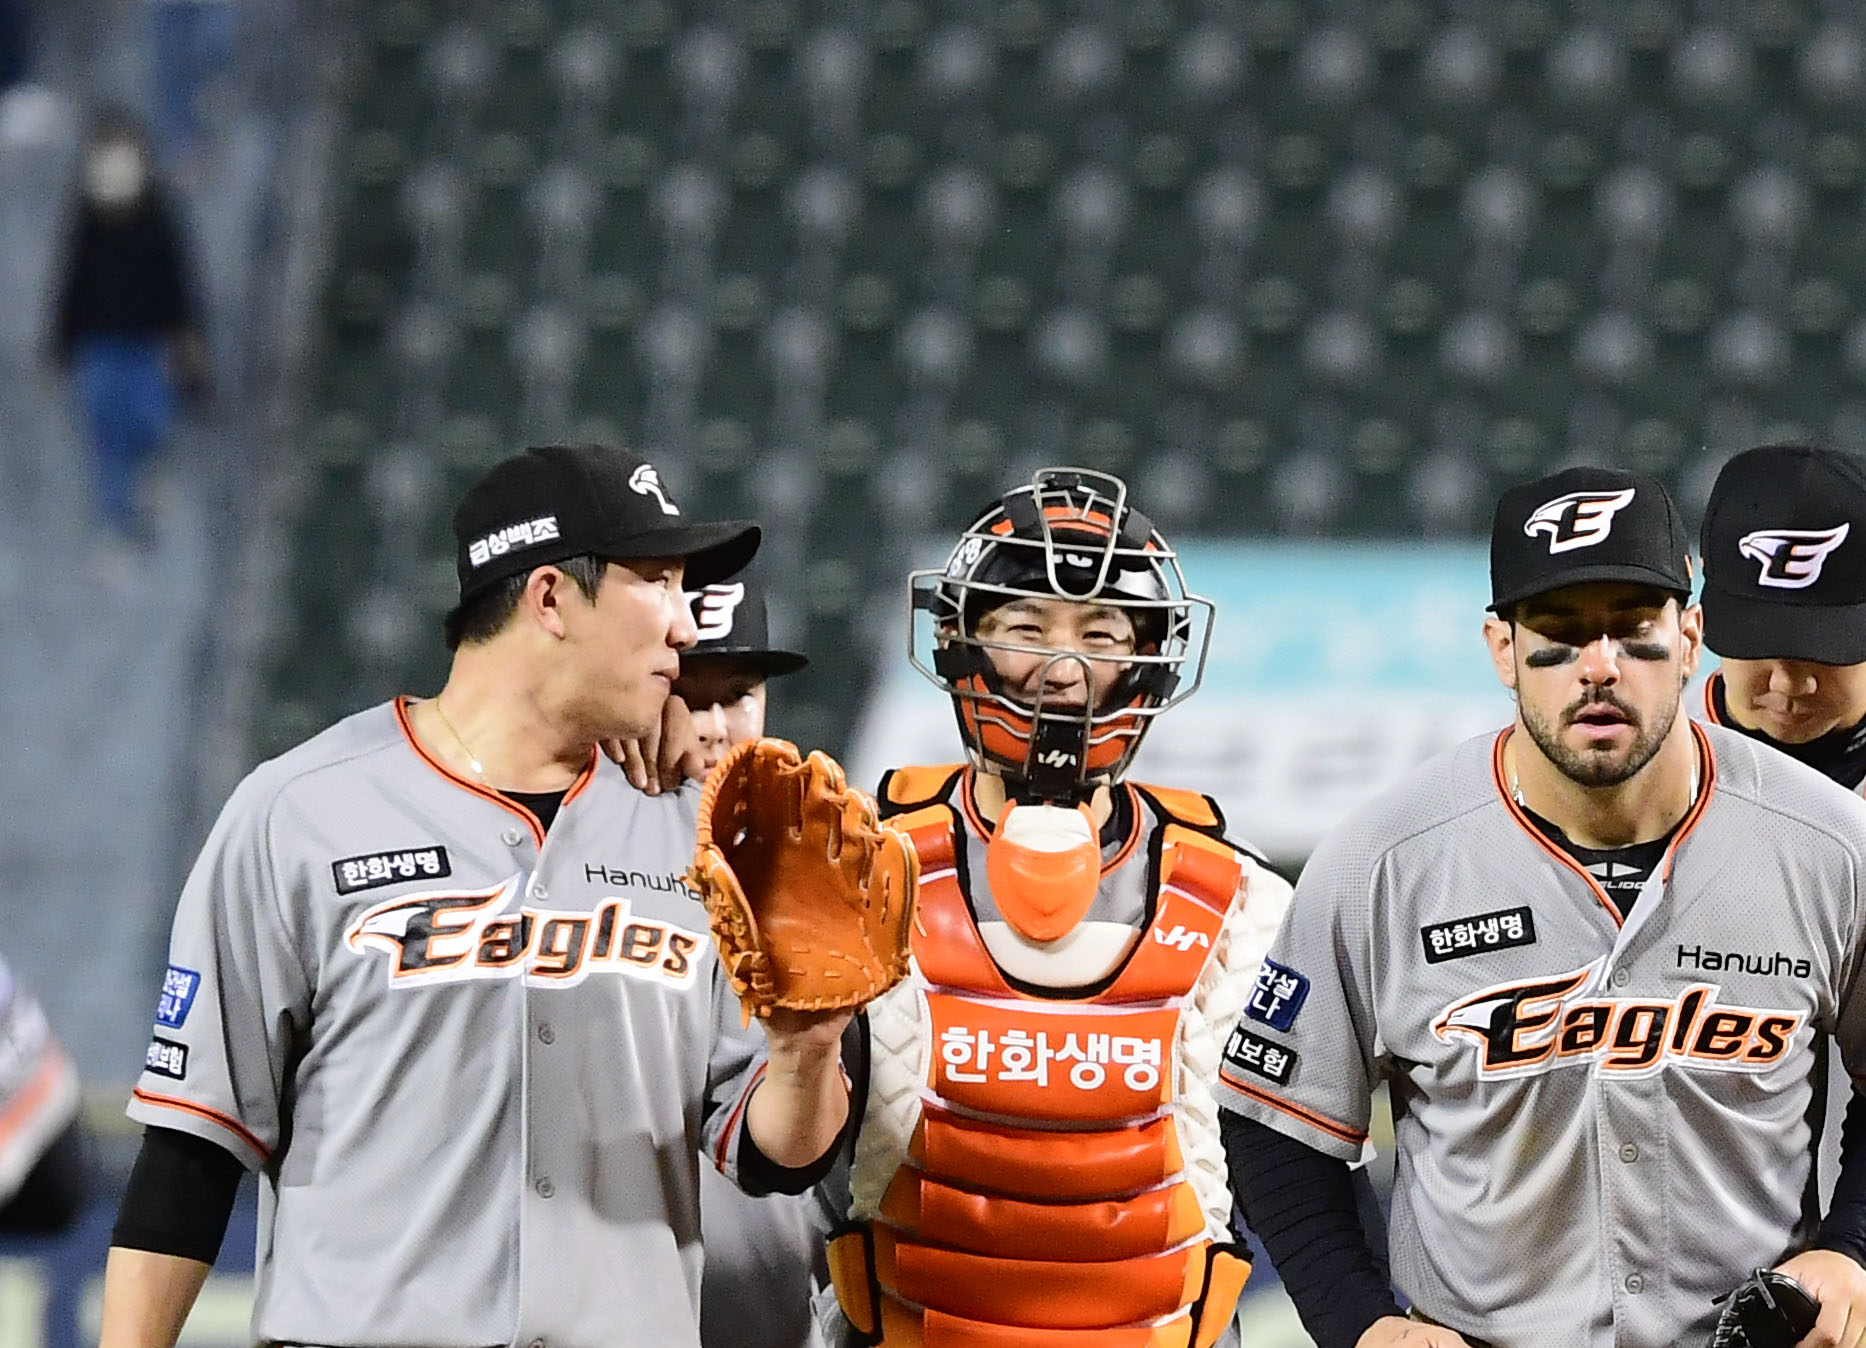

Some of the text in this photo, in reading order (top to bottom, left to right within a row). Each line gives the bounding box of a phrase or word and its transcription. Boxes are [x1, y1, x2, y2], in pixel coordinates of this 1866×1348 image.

[342, 849, 440, 886] 한화생명
[343, 871, 710, 990] Eagles
[1429, 912, 1524, 955] 한화생명
[1677, 944, 1811, 979] Hanwha
[1429, 955, 1808, 1082] Eagles
[940, 1025, 1162, 1091] 한화생명
